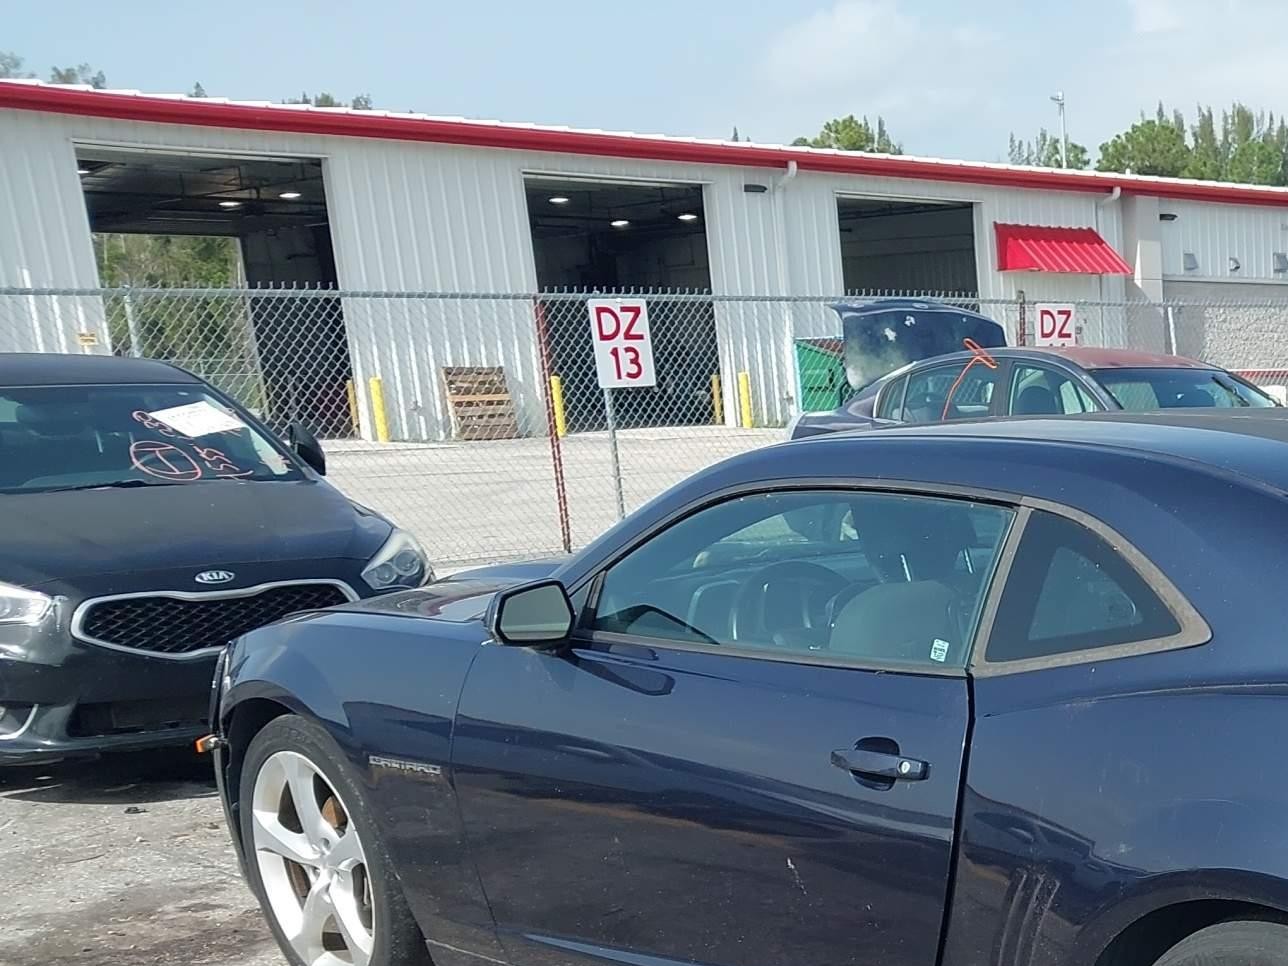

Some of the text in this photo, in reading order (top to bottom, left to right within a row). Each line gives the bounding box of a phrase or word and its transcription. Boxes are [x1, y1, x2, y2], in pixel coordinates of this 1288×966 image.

[594, 306, 645, 341] DZ
[1040, 309, 1072, 339] DZ
[609, 346, 643, 380] 13
[200, 571, 232, 581] KIA
